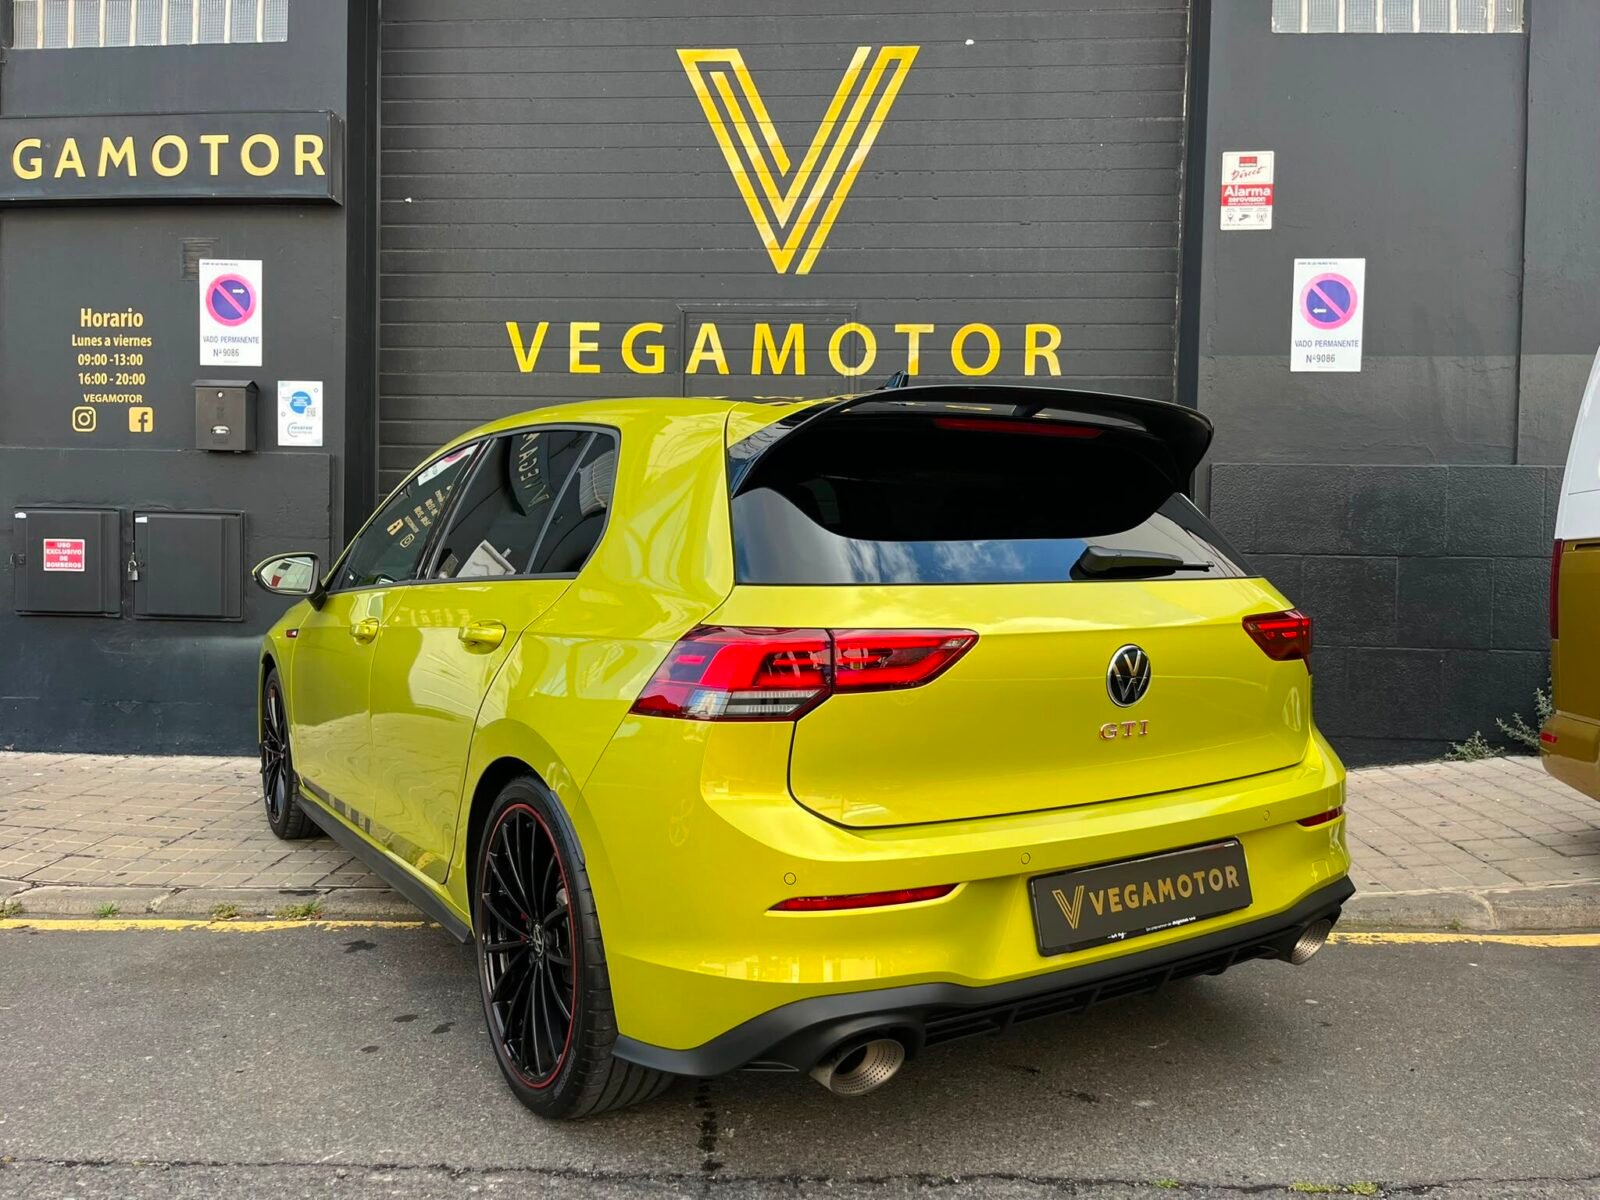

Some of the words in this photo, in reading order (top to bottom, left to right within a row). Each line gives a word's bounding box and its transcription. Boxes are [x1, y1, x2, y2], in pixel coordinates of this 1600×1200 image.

[11, 133, 326, 180] GAMOTOR
[1231, 166, 1266, 181] Direct
[1224, 185, 1270, 197] Alarma
[80, 308, 144, 328] Horario
[72, 334, 103, 347] Lunes
[104, 337, 111, 347] a
[113, 334, 152, 347] viernes
[203, 336, 219, 344] VADO
[220, 336, 260, 344] PERMANENTE
[1295, 339, 1313, 347] VADO
[1315, 339, 1360, 347] PERMANENTE
[506, 321, 1063, 377] VEGAMOTOR
[78, 354, 107, 366] 09:00
[78, 373, 107, 385] 16:00
[115, 373, 146, 385] 20:00
[83, 393, 143, 404] VEGAMOTOR
[1100, 720, 1149, 740] GTI
[1088, 864, 1241, 916] VEGAMOTOR
